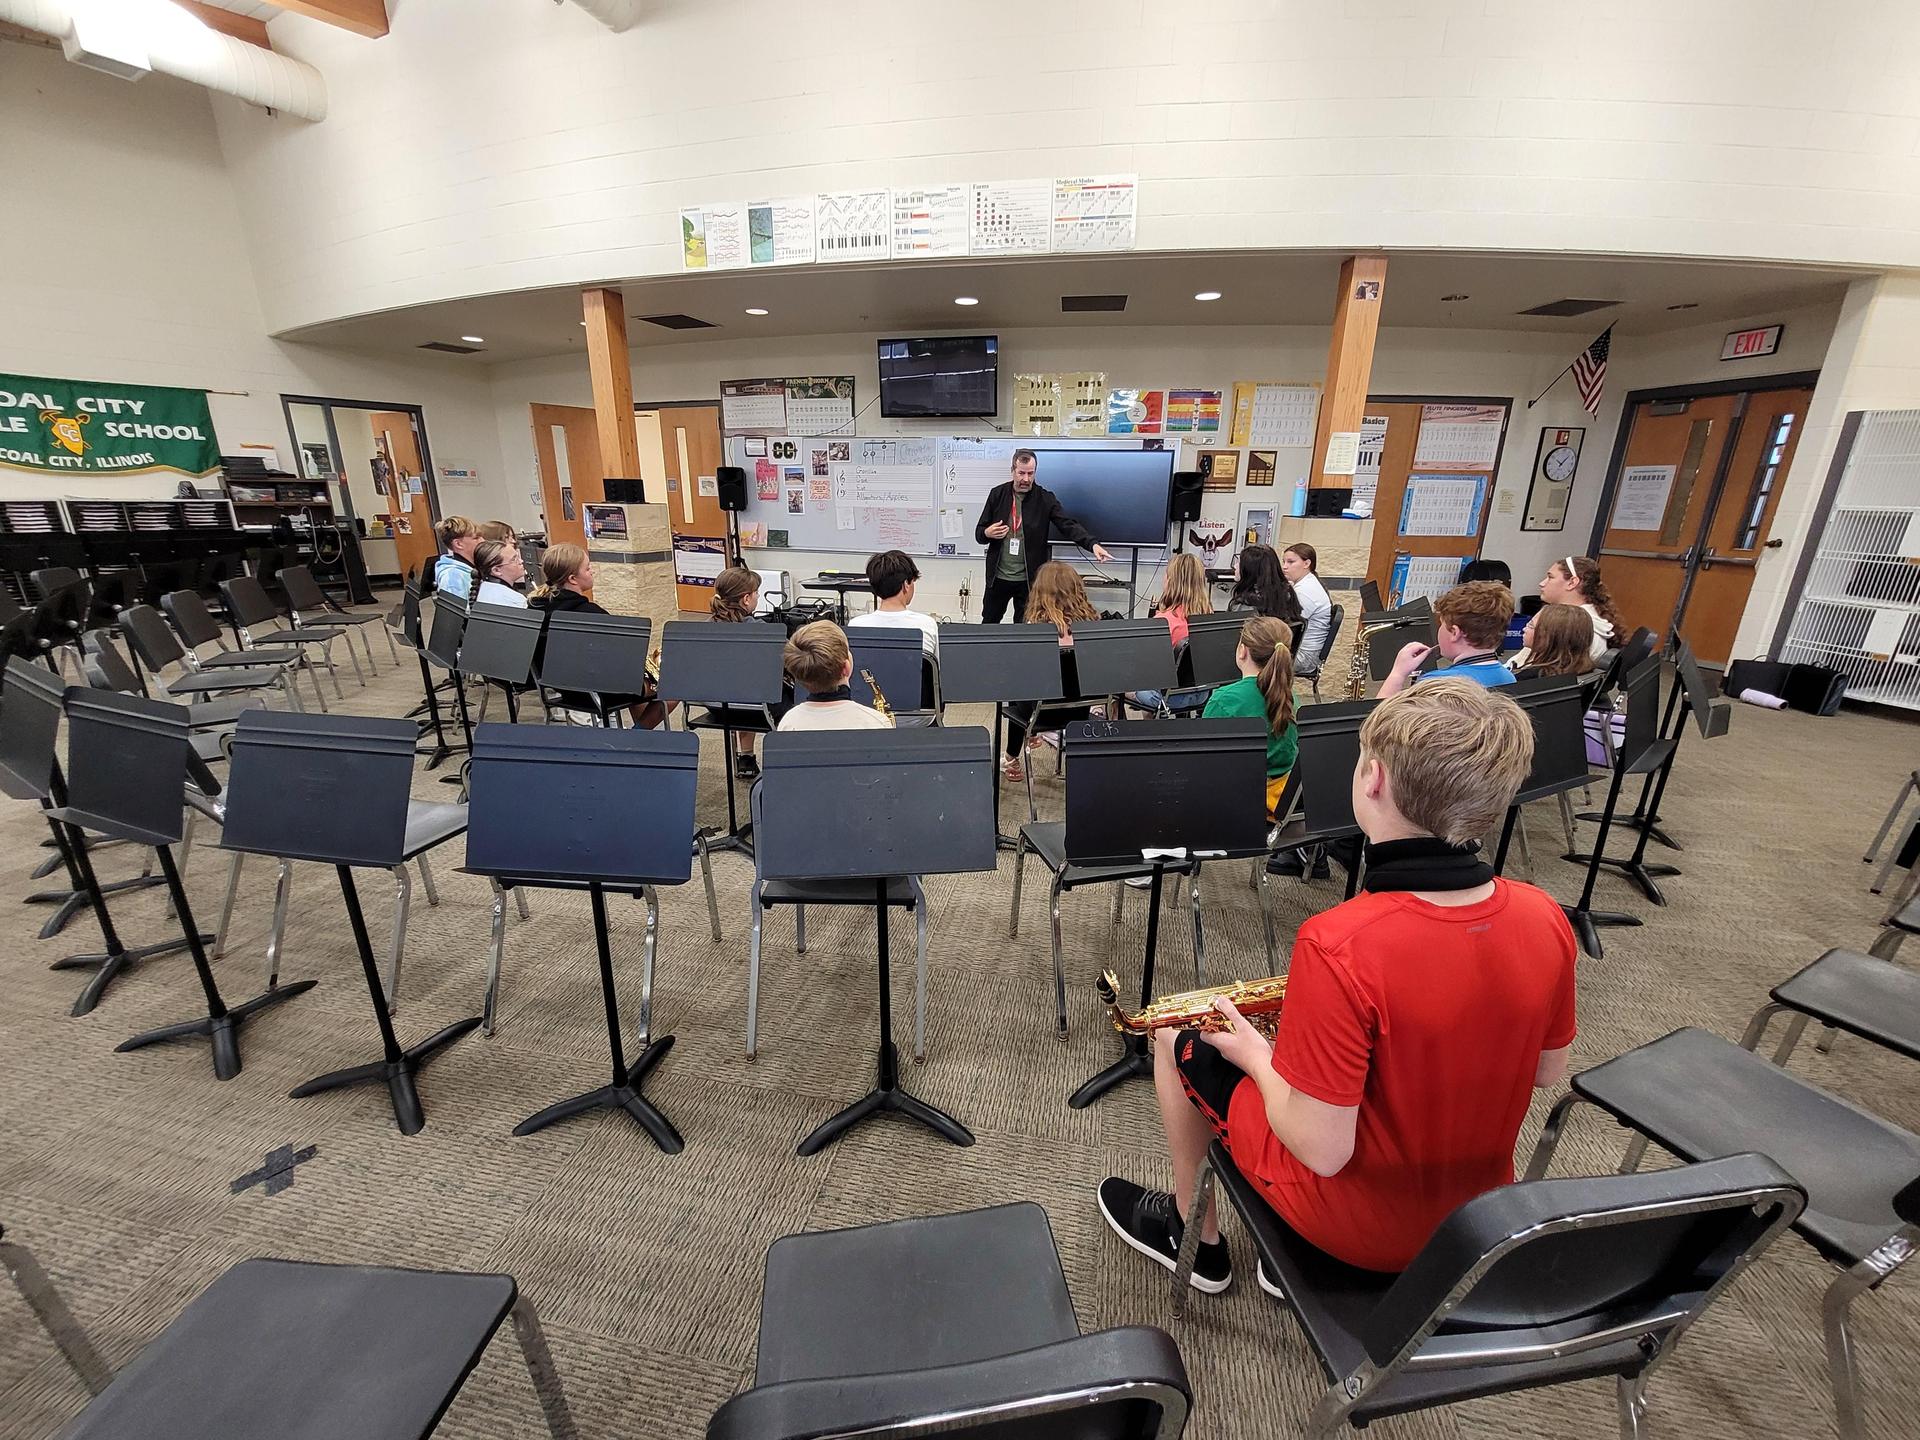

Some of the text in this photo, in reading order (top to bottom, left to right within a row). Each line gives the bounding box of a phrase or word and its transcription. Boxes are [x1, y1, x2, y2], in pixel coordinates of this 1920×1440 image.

[1733, 330, 1768, 354] EXIT
[77, 397, 146, 415] CITY
[1362, 417, 1386, 425] Basics
[104, 422, 206, 440] SCHOOL
[49, 455, 91, 468] CITY,
[96, 453, 155, 468] ILLINOIS
